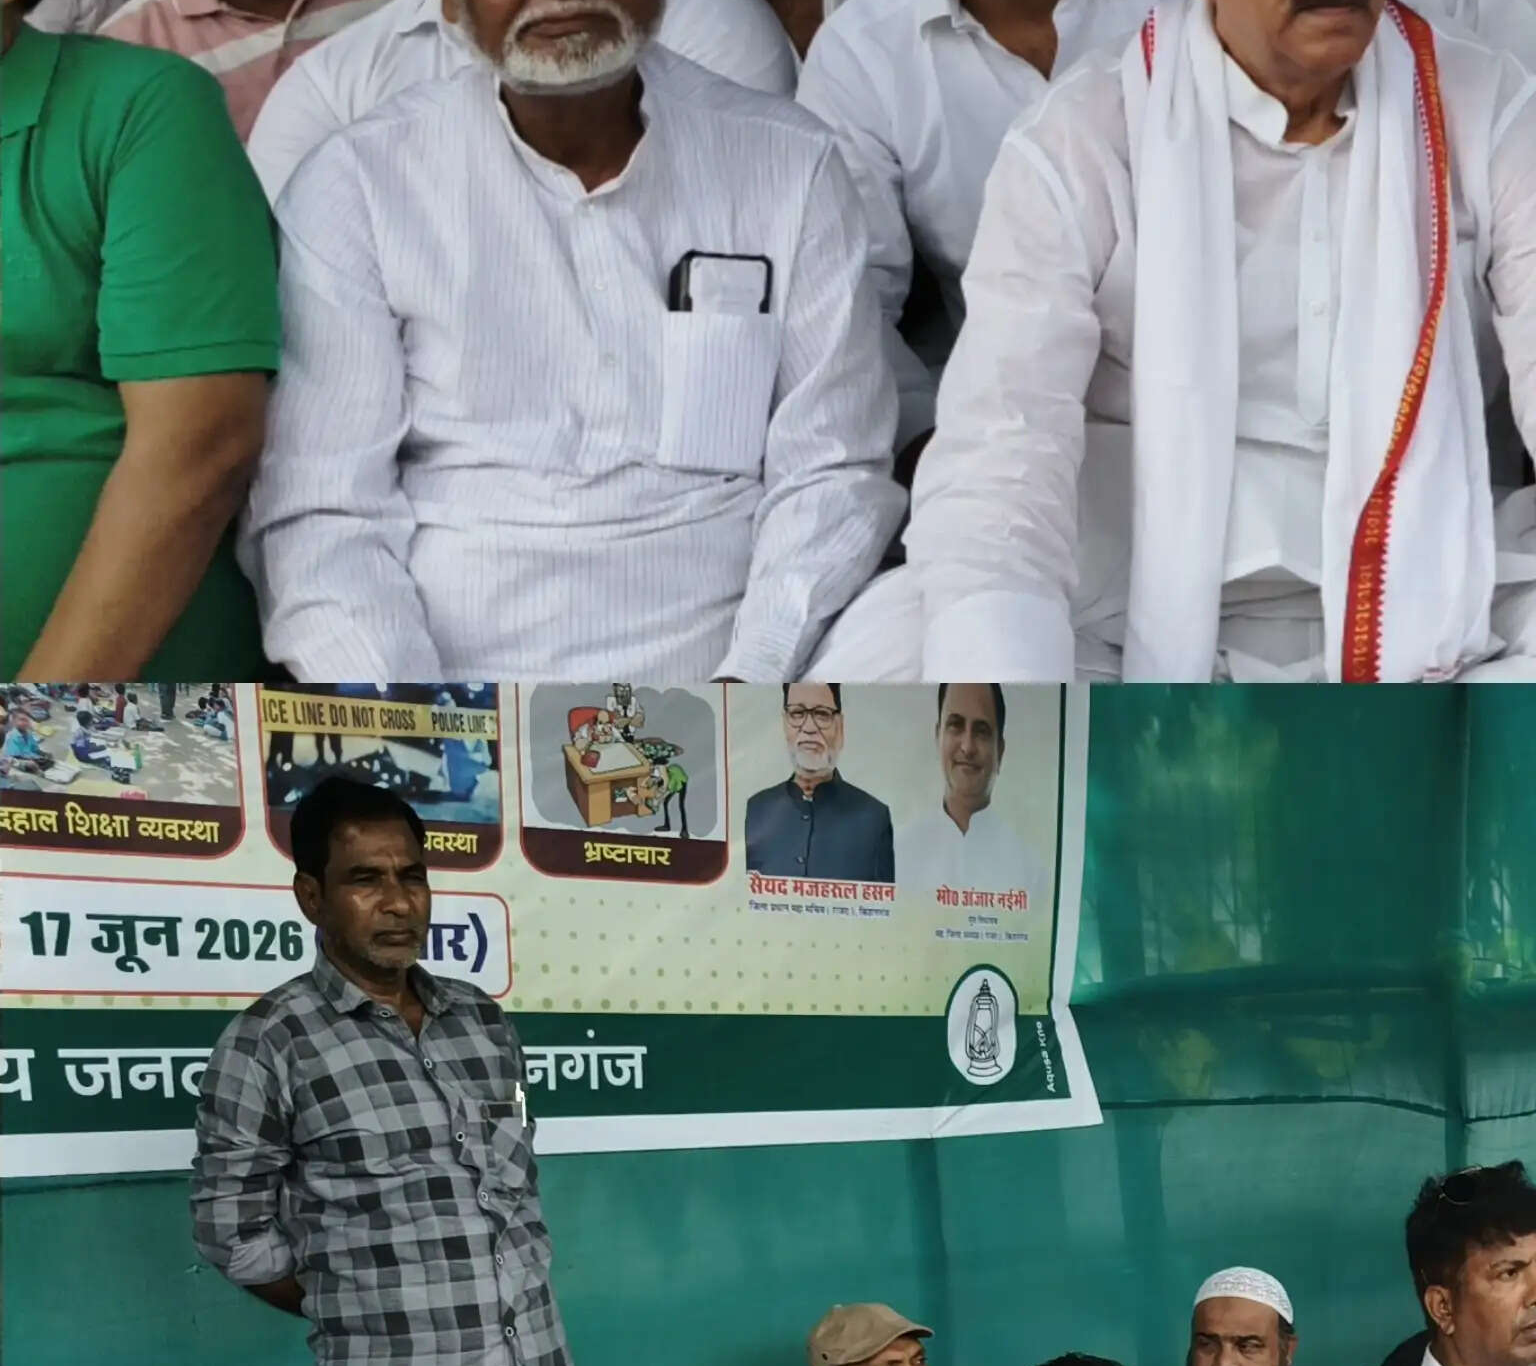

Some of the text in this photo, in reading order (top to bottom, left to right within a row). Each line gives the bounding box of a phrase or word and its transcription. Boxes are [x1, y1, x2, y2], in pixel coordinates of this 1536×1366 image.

[262, 697, 289, 725] ICE
[292, 700, 327, 727] LINE
[327, 703, 349, 728] DO
[351, 705, 377, 730] NOT
[379, 708, 417, 732] CROSS
[431, 711, 466, 733] POLICE
[0, 801, 220, 844] दहाल शिक्षा व्यवस्था
[424, 830, 478, 854] यवस्था
[583, 840, 672, 866] भ्रष्टाचार
[749, 870, 789, 896] सैयद
[861, 884, 896, 902] हसन
[962, 886, 995, 908] अंजार
[19, 910, 304, 974] 17 जून 2026
[57, 1046, 214, 1102] जन
[521, 1028, 647, 1091] नगंज
